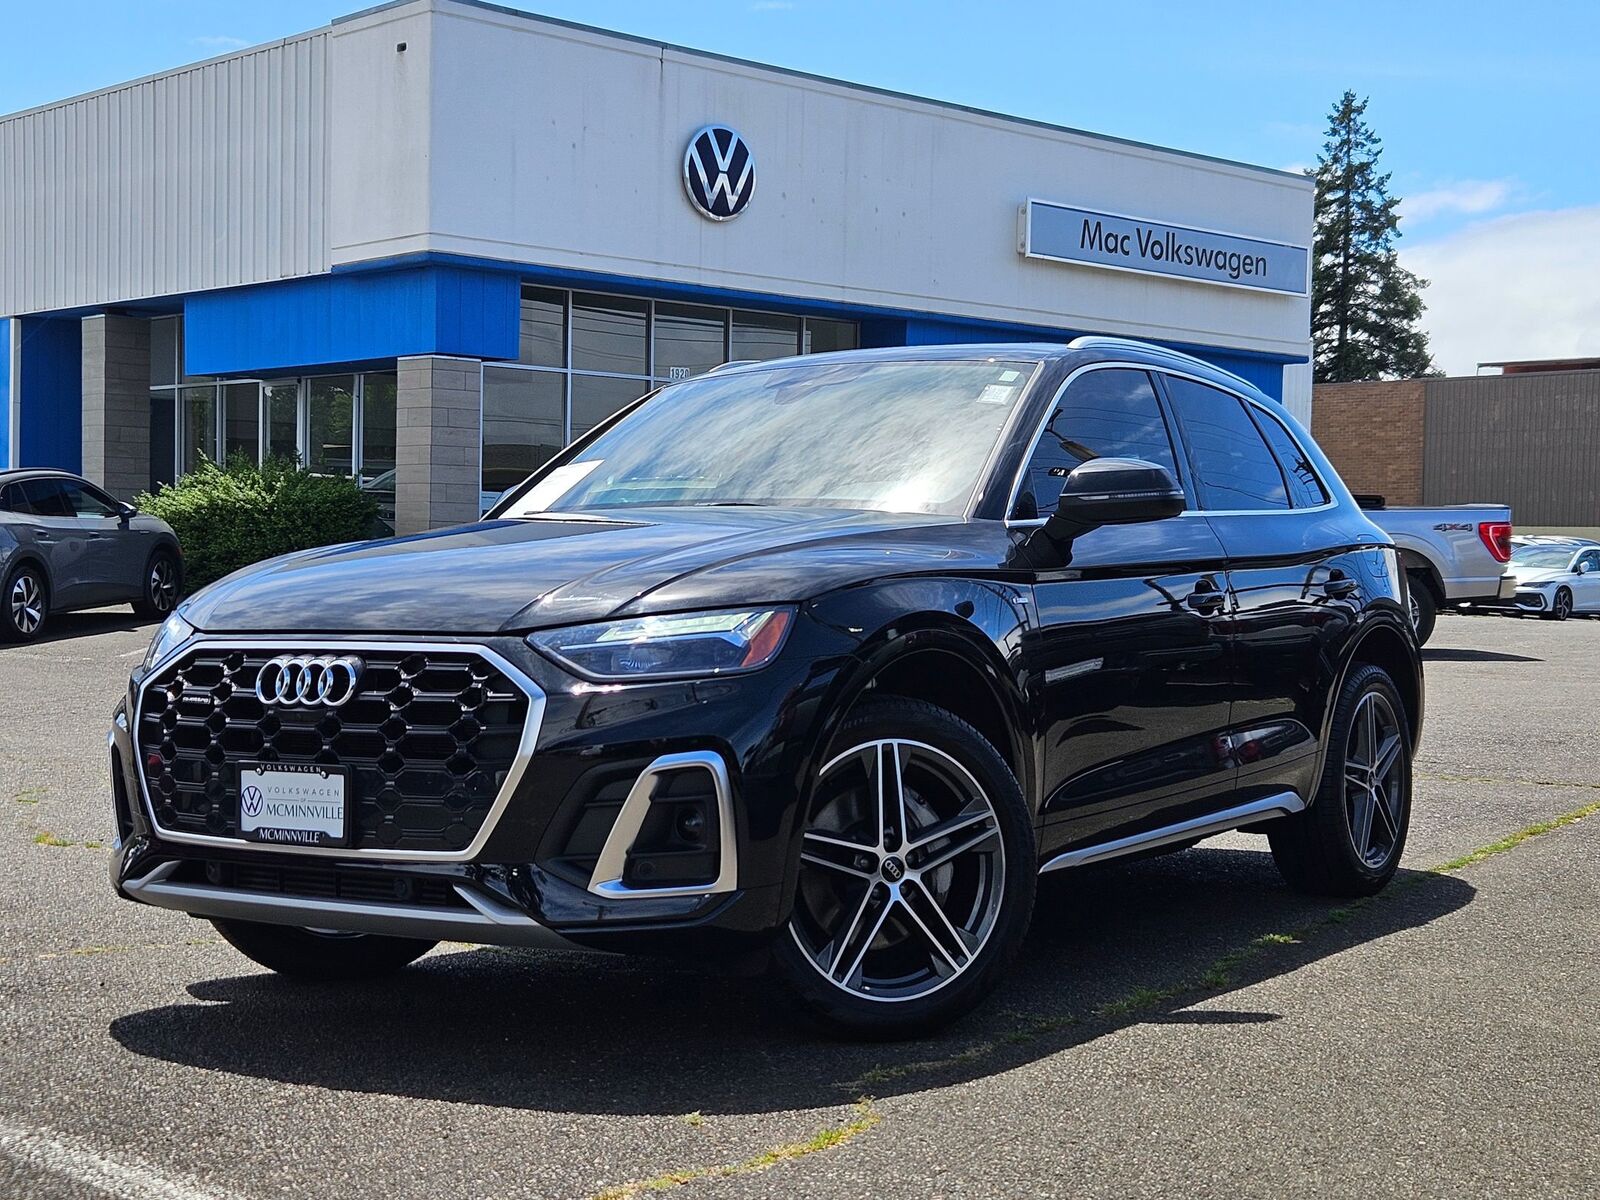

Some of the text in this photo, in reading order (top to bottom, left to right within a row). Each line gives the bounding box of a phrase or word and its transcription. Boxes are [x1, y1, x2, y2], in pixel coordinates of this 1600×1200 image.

[1080, 218, 1267, 280] Mac Volkswagen
[260, 763, 321, 773] VOLKSWAGEN
[267, 786, 340, 797] VOLKSWAGEN
[266, 803, 343, 820] MCMINNVILLE
[259, 828, 320, 843] MCMINNVILLE
